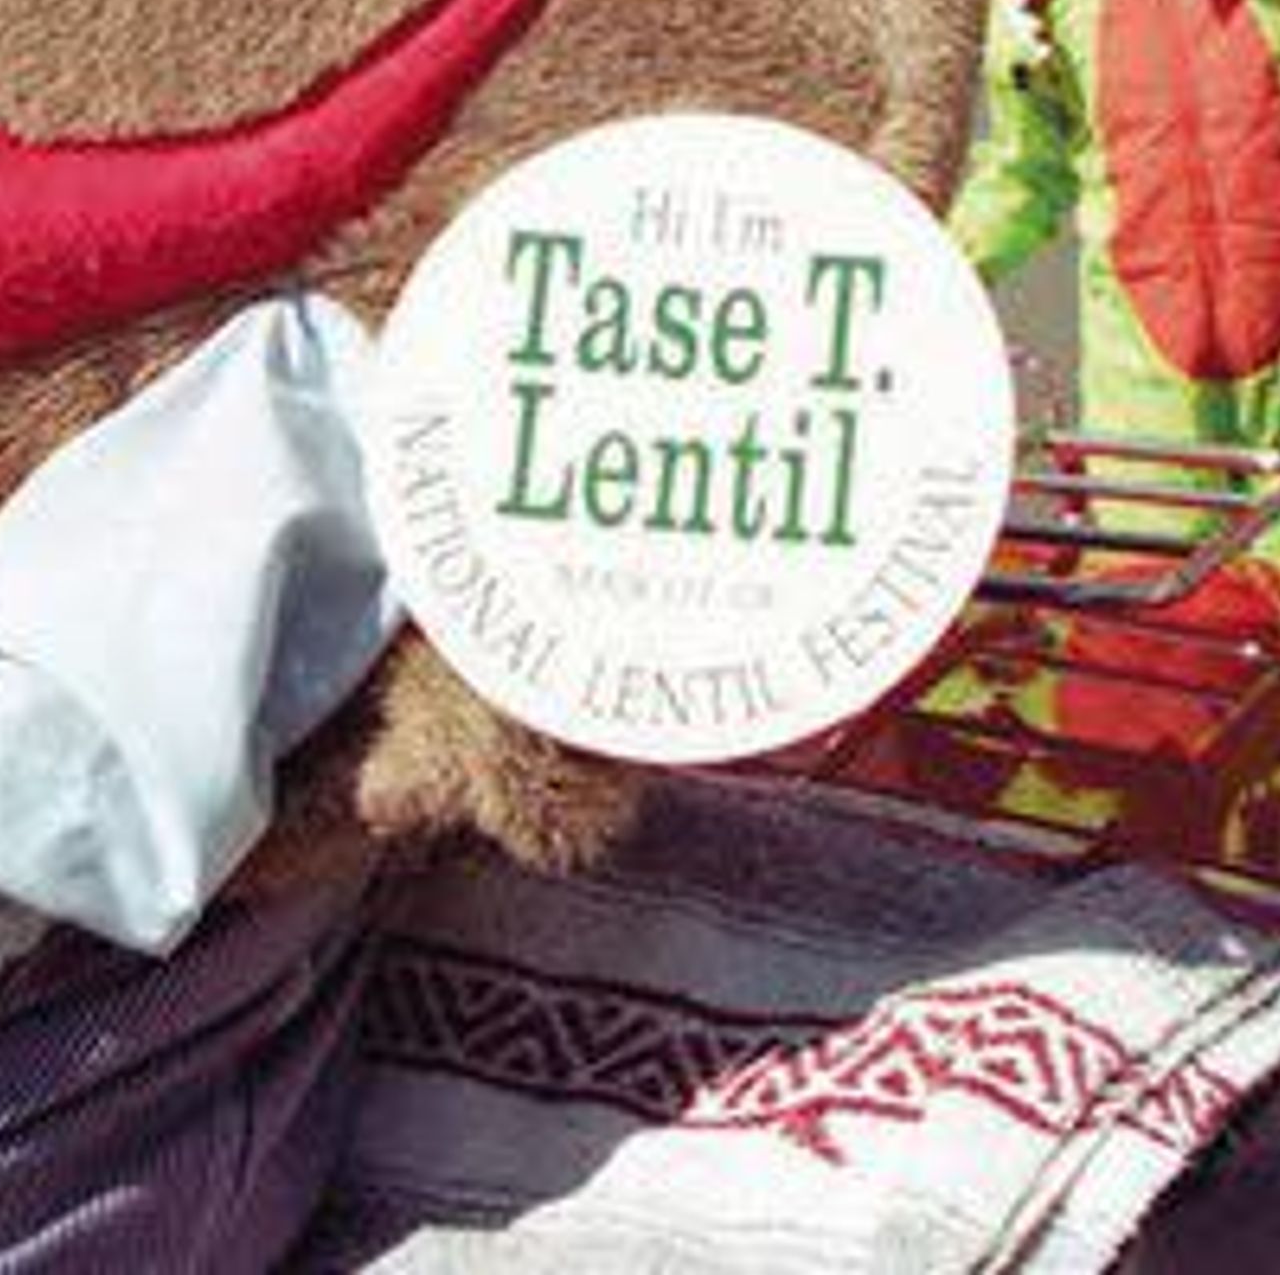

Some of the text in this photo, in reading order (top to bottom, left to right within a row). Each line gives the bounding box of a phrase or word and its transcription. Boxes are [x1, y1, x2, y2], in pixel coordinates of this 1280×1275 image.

[505, 229, 894, 392] Tase T.
[495, 382, 858, 547] Lentil
[393, 410, 982, 727] NATIONAL LENTIL FESTIVAL
